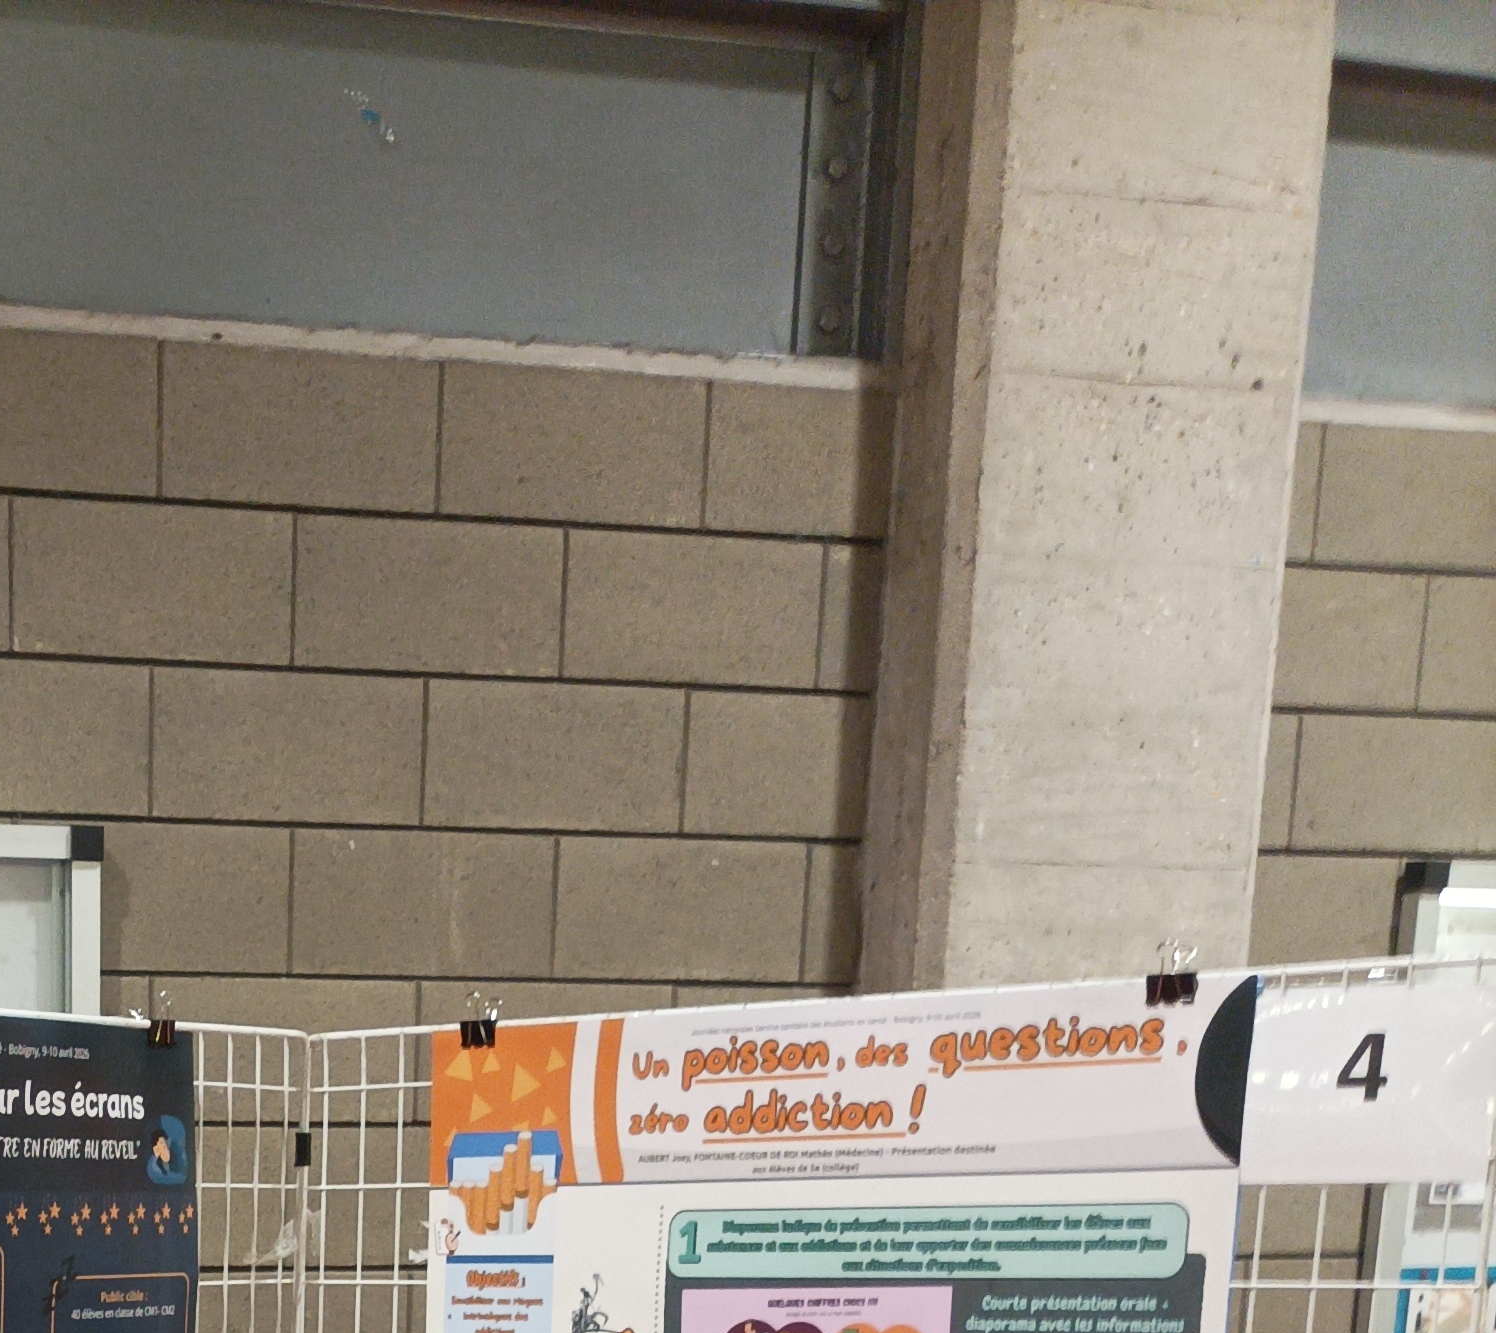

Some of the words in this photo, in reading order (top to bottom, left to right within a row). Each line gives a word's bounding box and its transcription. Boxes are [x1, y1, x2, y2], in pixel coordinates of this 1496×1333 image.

[632, 1050, 670, 1081] Un
[855, 1036, 909, 1069] des
[1335, 1033, 1388, 1104] 4
[24, 1079, 66, 1117] les
[70, 1082, 145, 1121] écrans
[628, 1103, 690, 1136] zéro
[702, 1088, 894, 1136] addiction
[908, 1083, 926, 1134] !
[23, 1137, 40, 1158] EN
[42, 1138, 81, 1159] FORME
[84, 1139, 99, 1160] AU
[677, 1221, 702, 1264] 1
